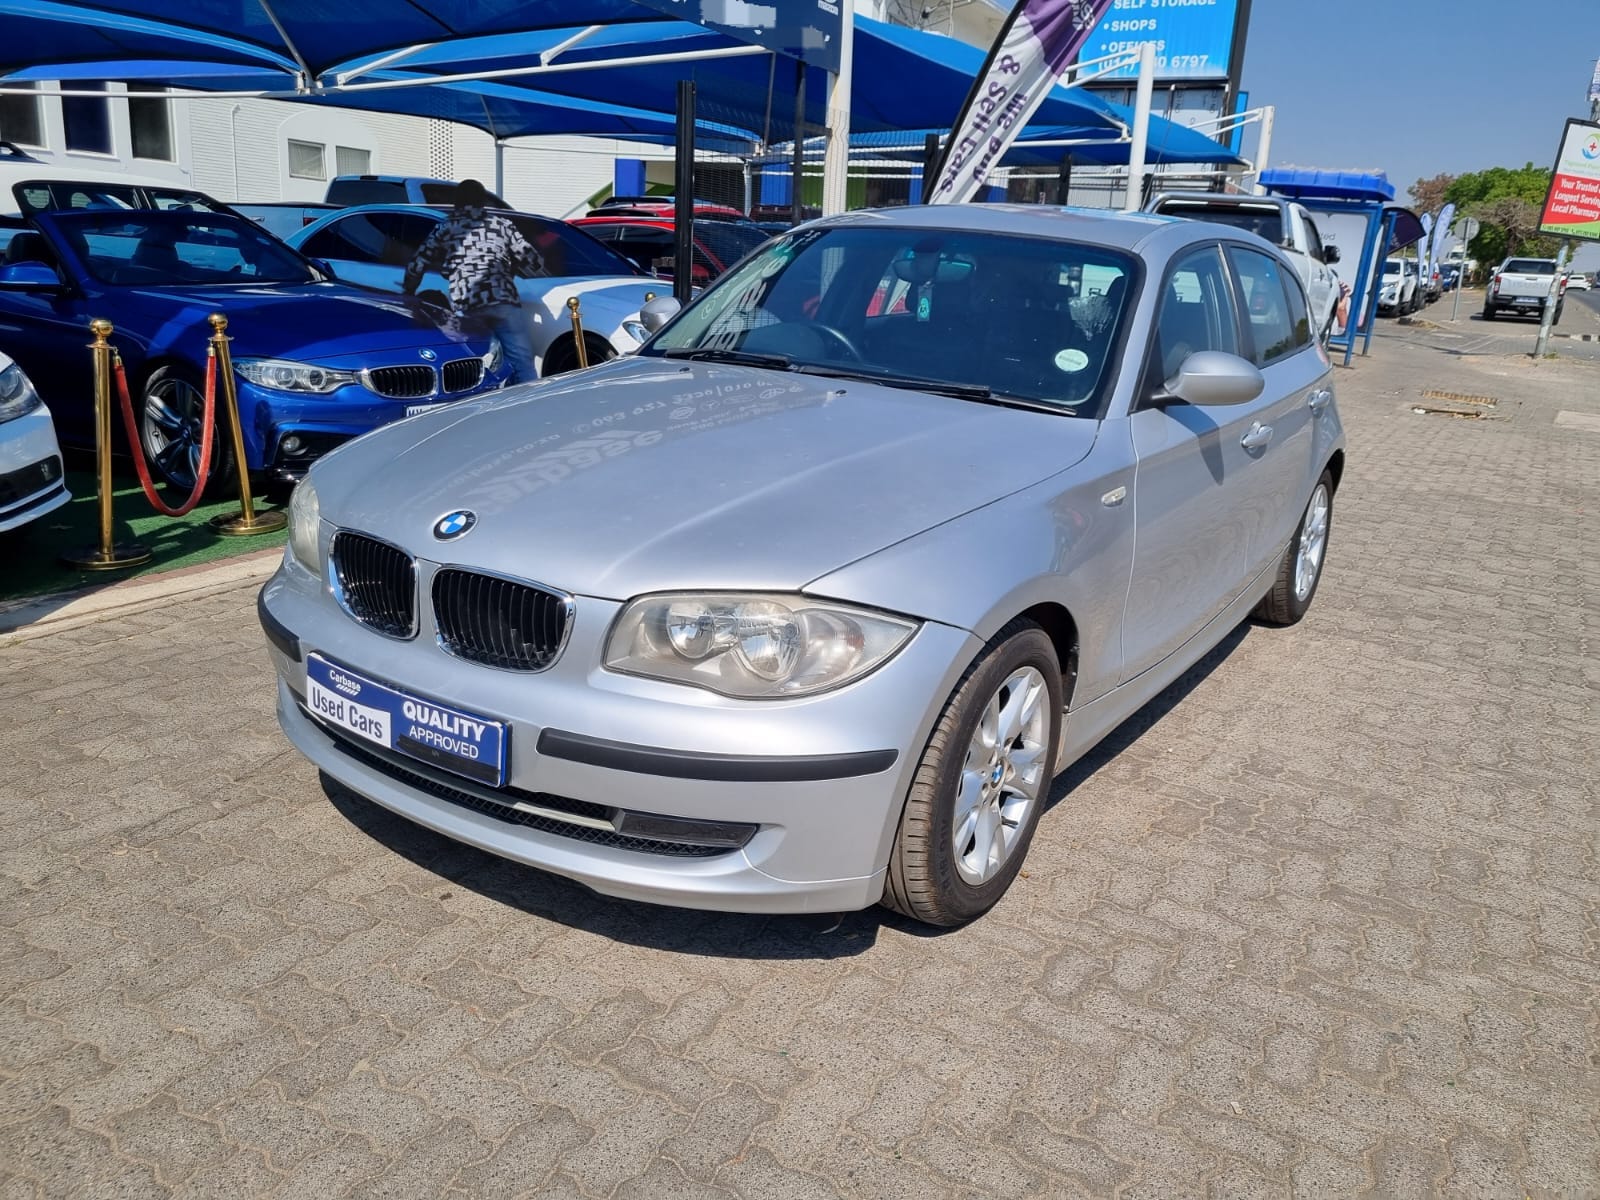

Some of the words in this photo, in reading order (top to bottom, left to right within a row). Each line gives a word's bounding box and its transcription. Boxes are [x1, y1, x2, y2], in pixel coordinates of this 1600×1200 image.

[1113, 0, 1146, 9] SELF
[1111, 19, 1157, 31] SHOPS
[998, 54, 1020, 76] &
[1171, 55, 1208, 68] 6797
[972, 81, 1008, 133] Sell
[997, 92, 1028, 130] We
[940, 137, 977, 192] Cars
[972, 135, 1003, 183] Buy
[1561, 178, 1576, 189] Your
[1554, 190, 1580, 203] Longest
[1551, 202, 1570, 214] Local
[1569, 205, 1599, 220] Pharmacy
[329, 669, 361, 691] Carbase
[312, 686, 345, 722] Used
[349, 705, 383, 740] Cars
[402, 700, 486, 742] QUALITY
[409, 725, 479, 760] APPROVED
